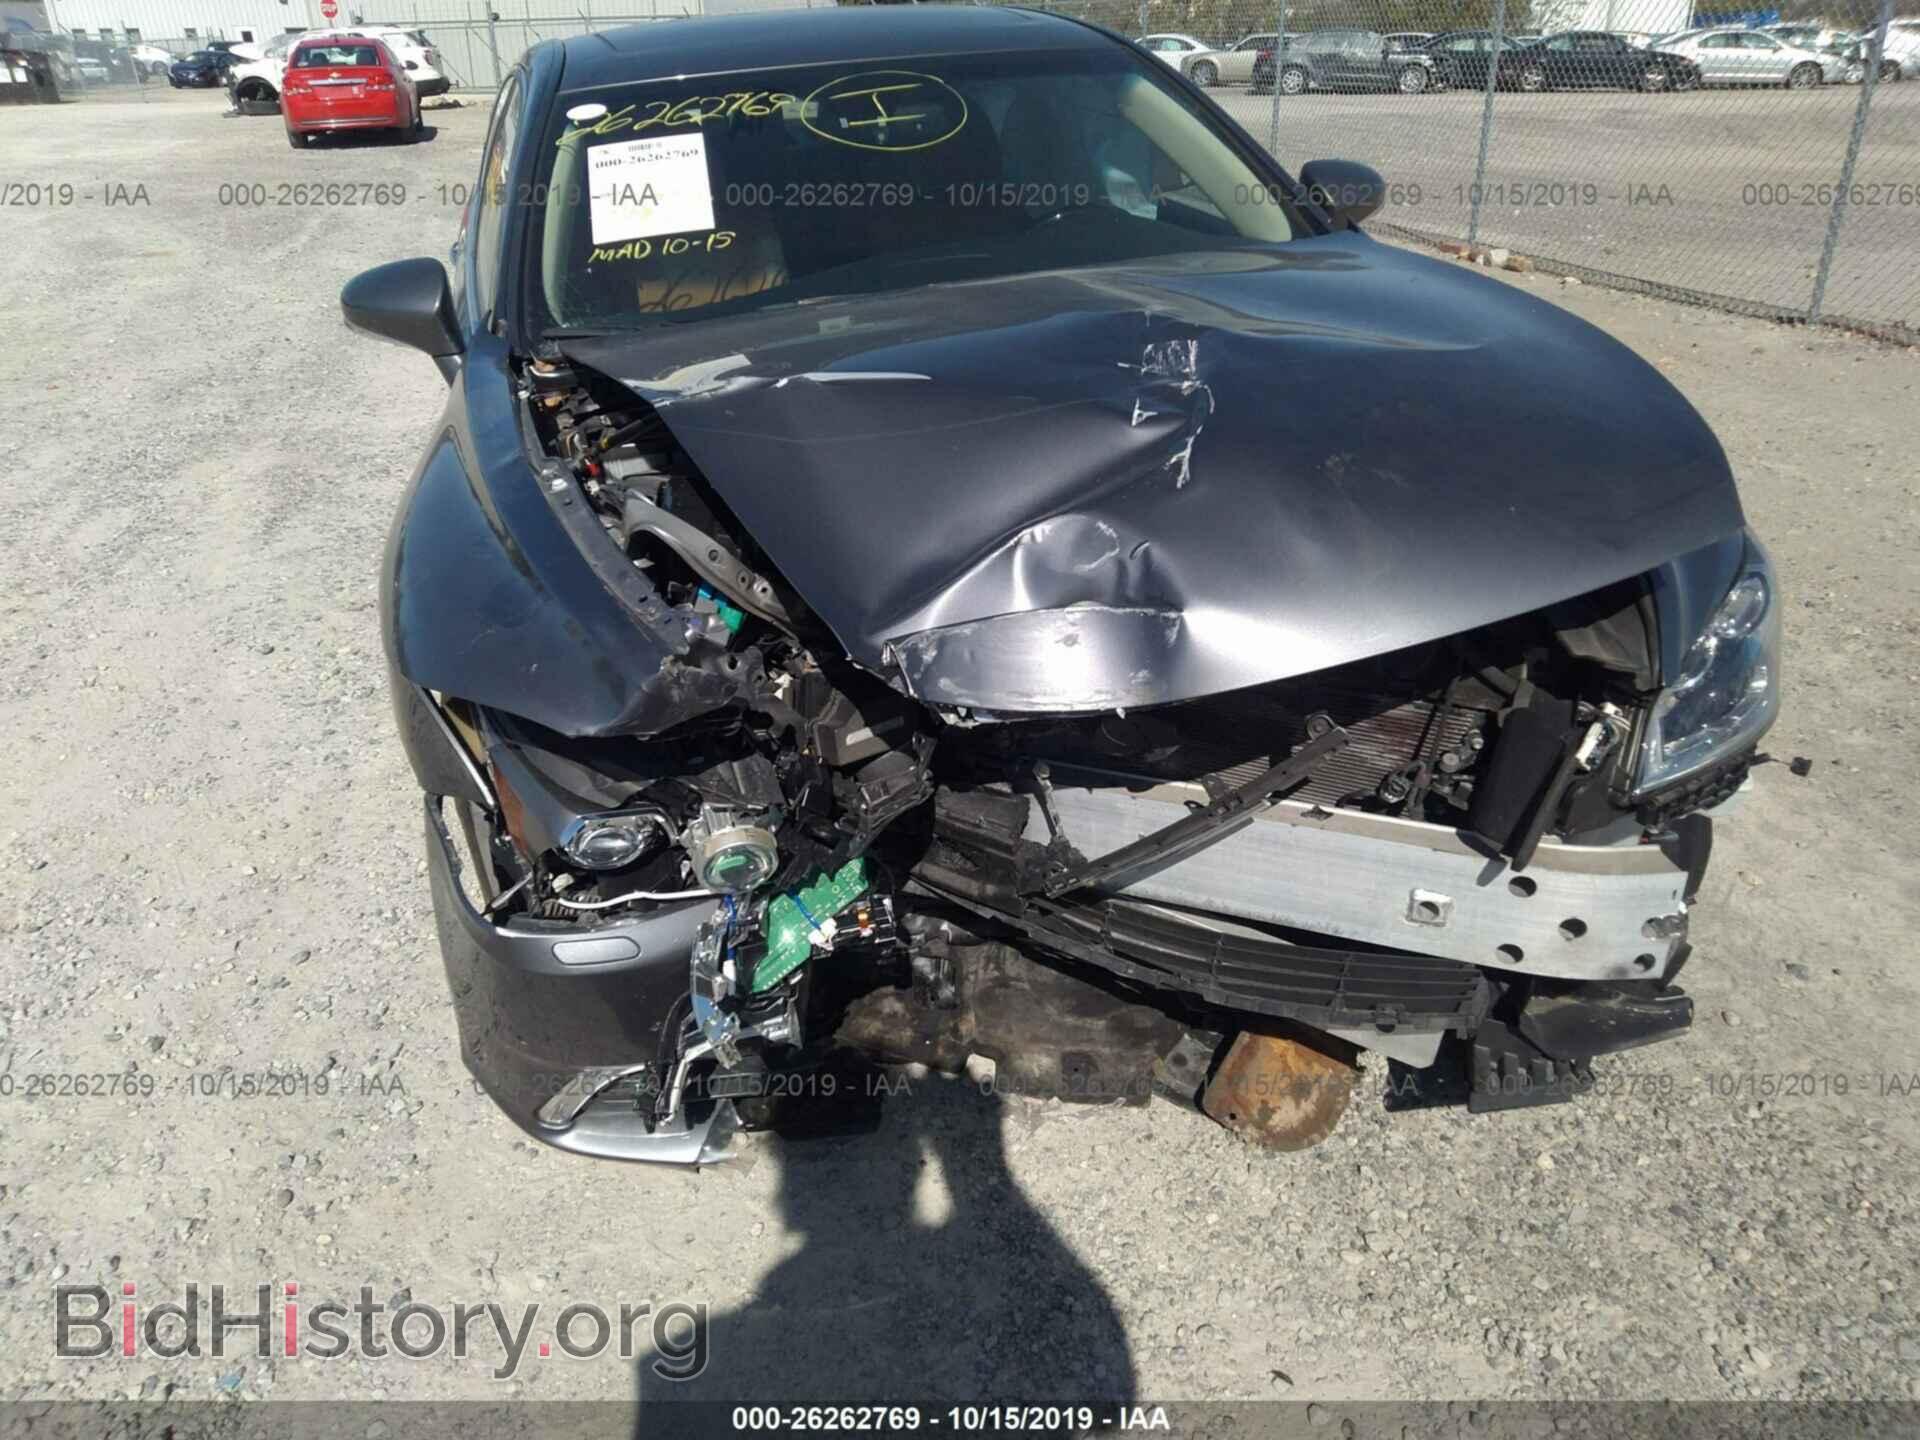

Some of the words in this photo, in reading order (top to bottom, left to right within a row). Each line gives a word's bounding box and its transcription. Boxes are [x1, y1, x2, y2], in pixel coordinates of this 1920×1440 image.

[555, 91, 796, 146] 26262769
[589, 240, 650, 263] MAD
[663, 231, 736, 255] 10-15
